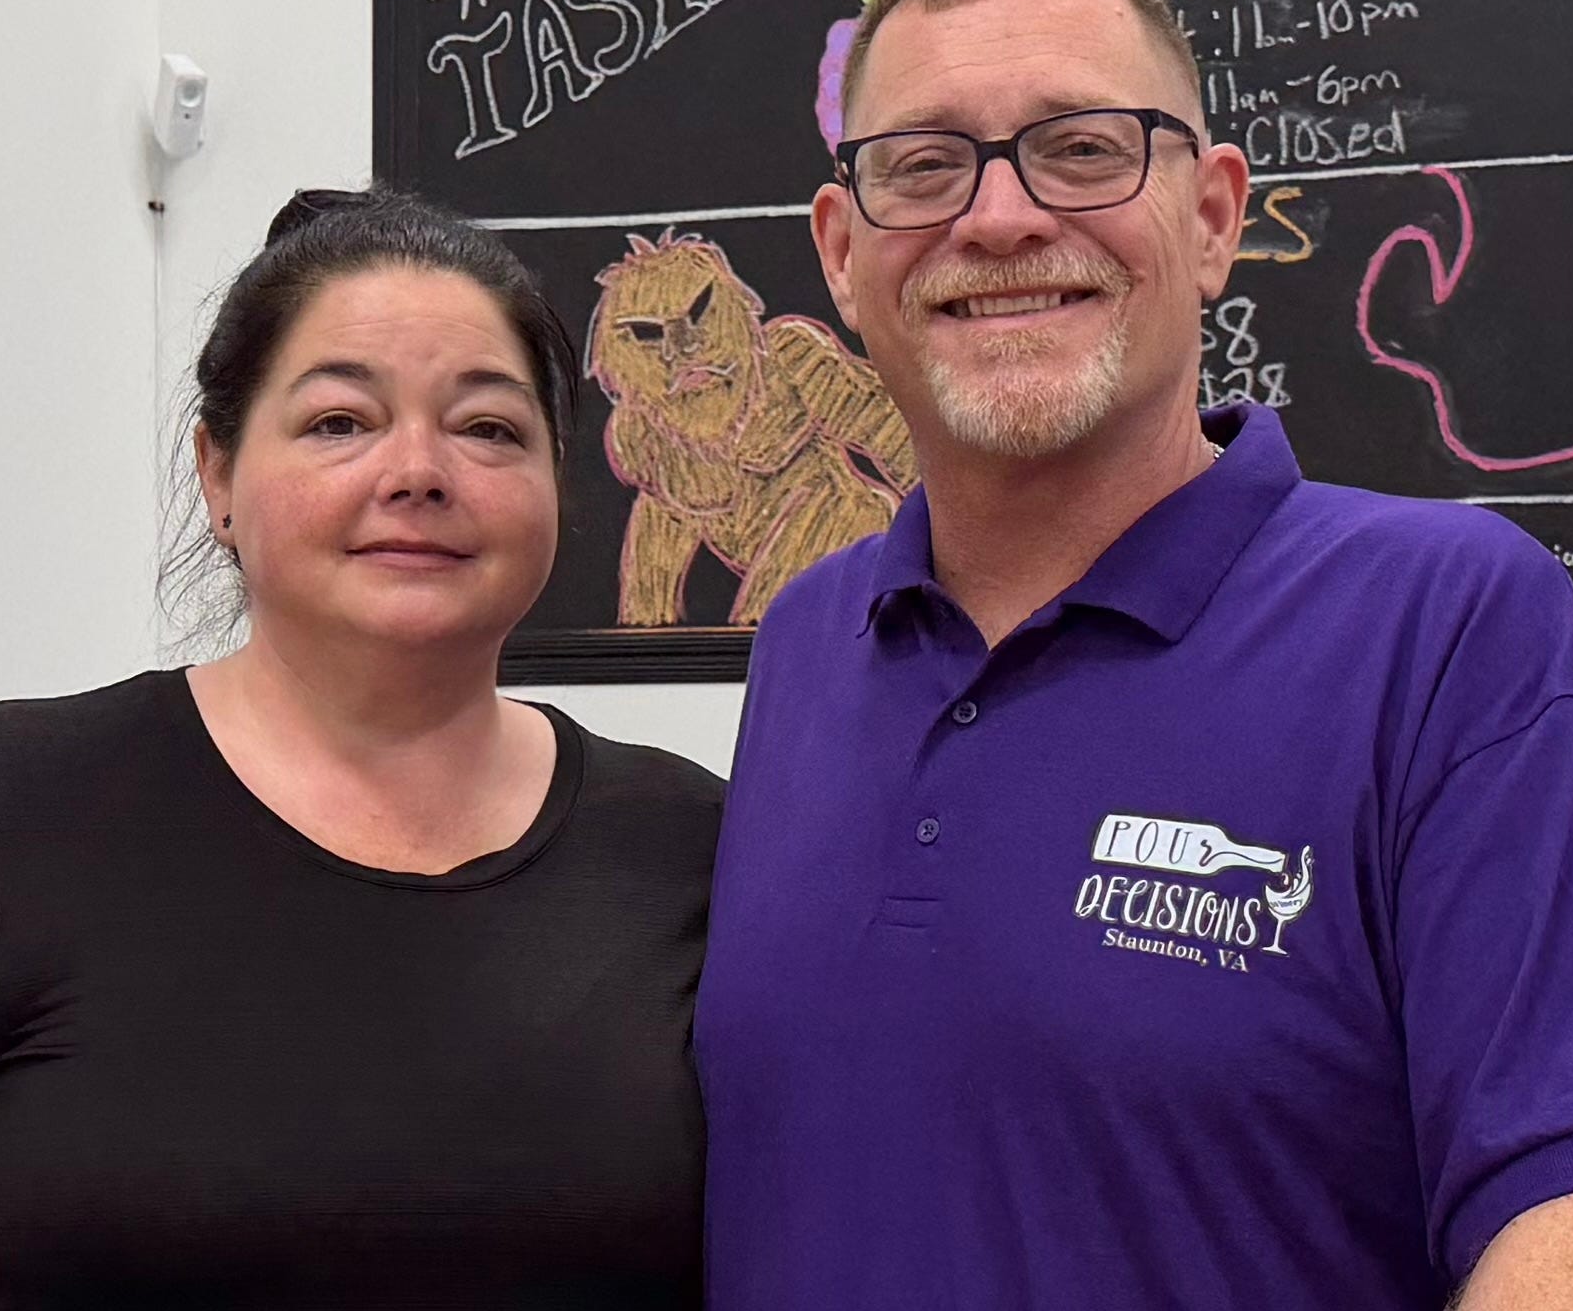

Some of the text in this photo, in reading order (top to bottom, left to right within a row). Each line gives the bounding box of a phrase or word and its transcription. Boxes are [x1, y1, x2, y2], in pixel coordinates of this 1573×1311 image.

[1074, 874, 1262, 947] DECISIONS
[1101, 928, 1250, 974] Staunton, VA
